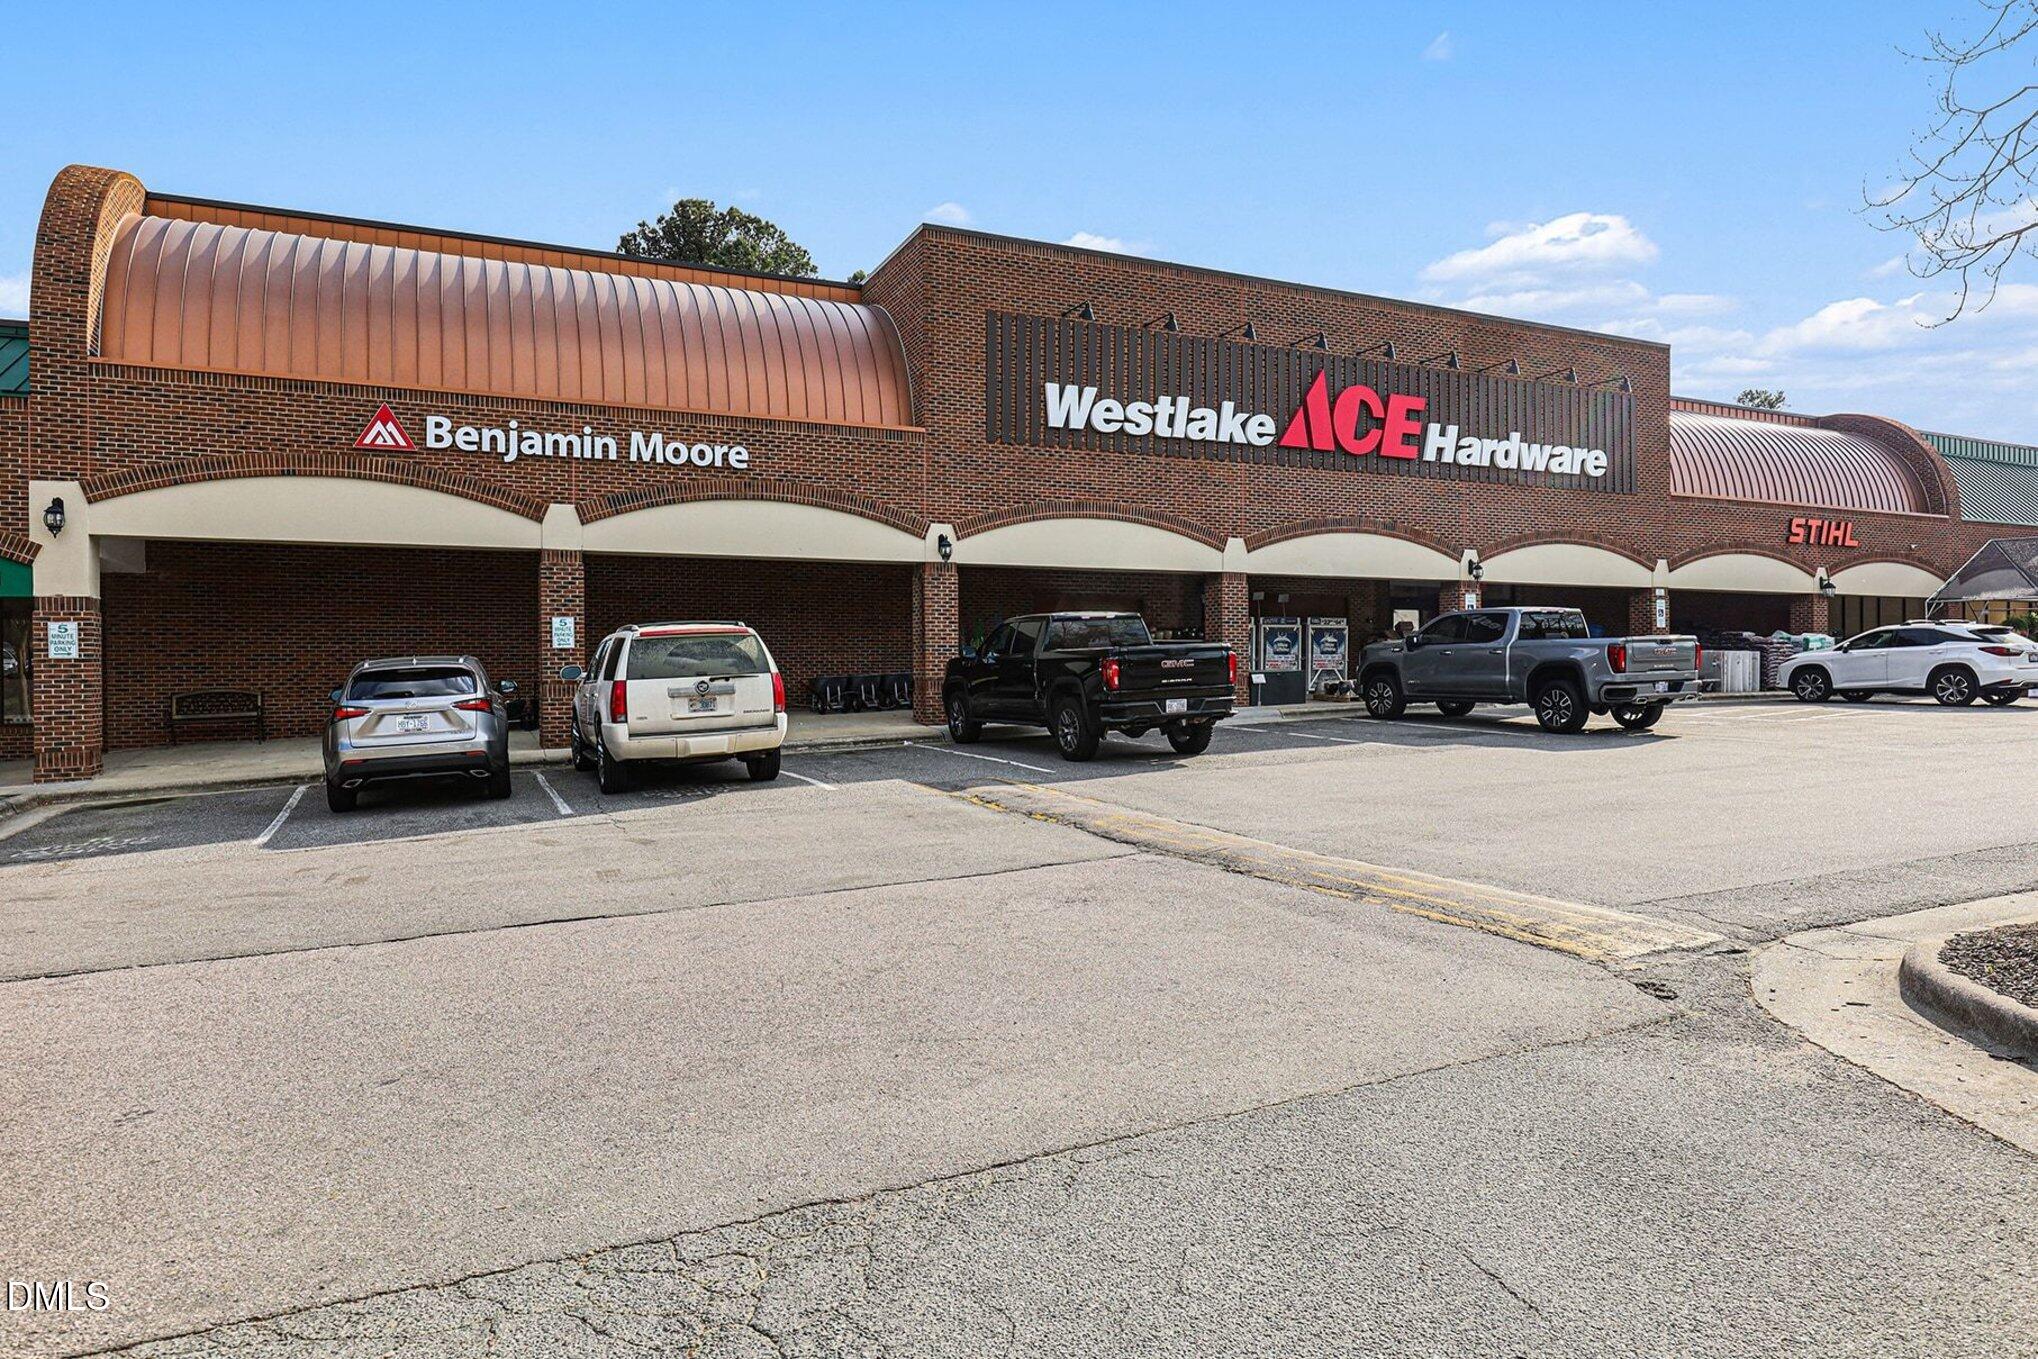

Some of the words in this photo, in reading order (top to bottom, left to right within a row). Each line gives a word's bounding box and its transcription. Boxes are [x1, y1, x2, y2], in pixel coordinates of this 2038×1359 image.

[1044, 382, 1277, 447] Westlake
[1278, 368, 1428, 460] ACE
[1422, 422, 1609, 478] Hardware
[425, 414, 618, 463] Benjamin
[629, 431, 750, 470] Moore
[1788, 517, 1860, 547] STIHL
[57, 624, 69, 634] 5
[559, 618, 568, 627] 5
[53, 645, 73, 653] ONLY
